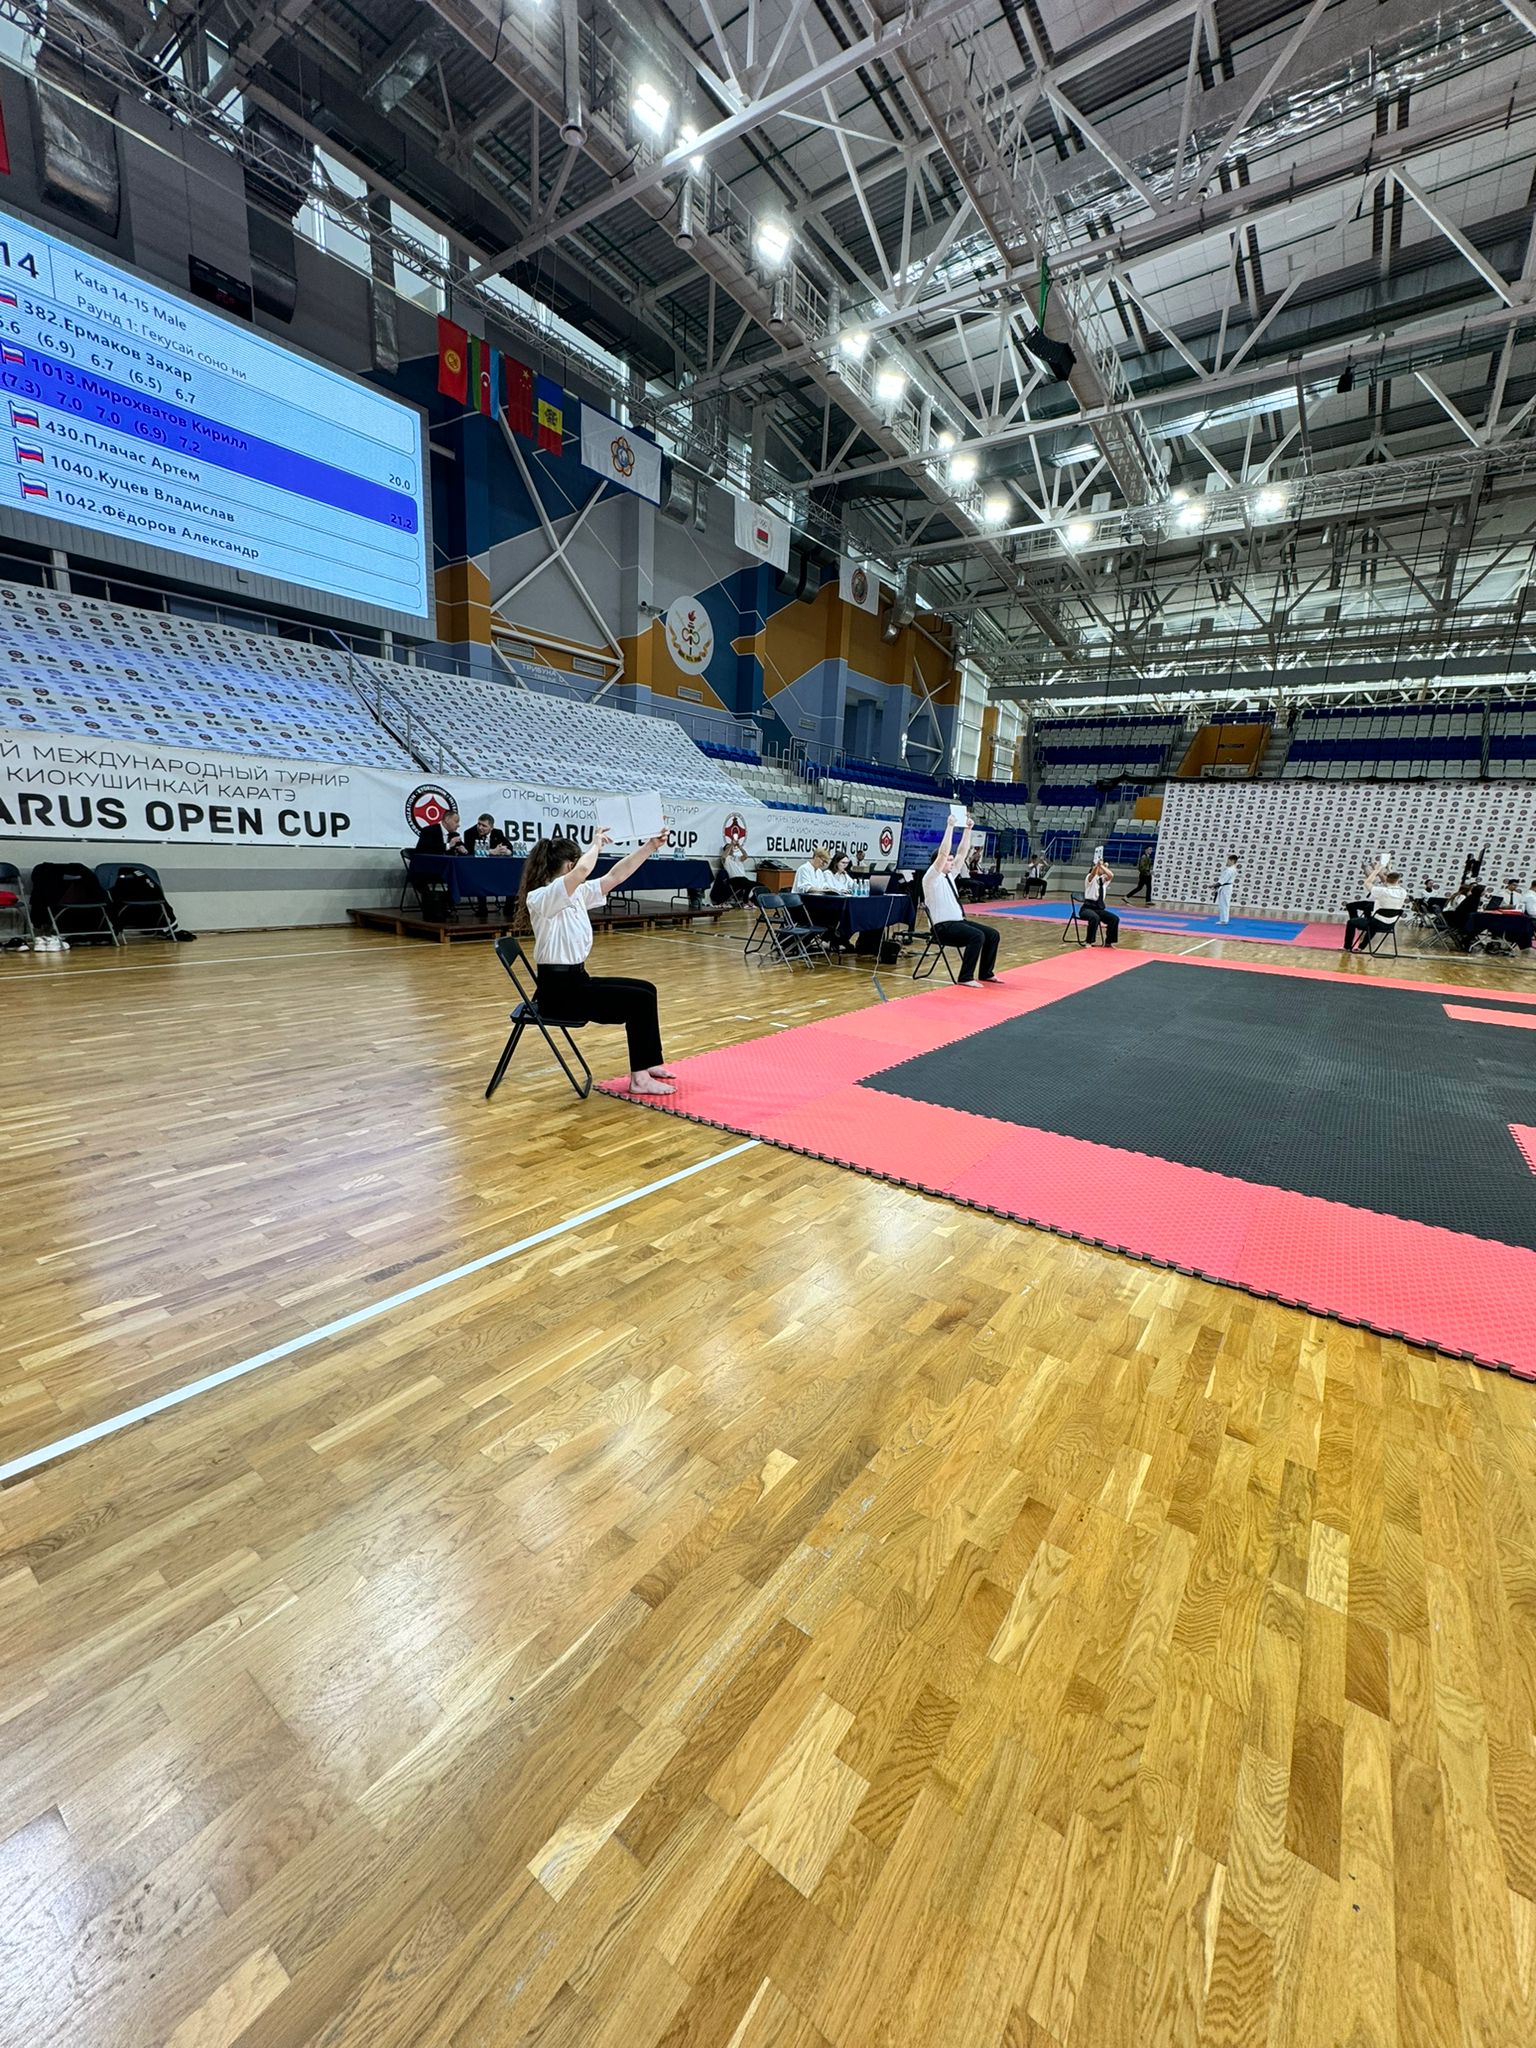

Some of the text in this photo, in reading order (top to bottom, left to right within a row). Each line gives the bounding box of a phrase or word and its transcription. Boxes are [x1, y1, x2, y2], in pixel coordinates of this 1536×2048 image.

[74, 269, 187, 331] Kata 14-15 Male
[23, 300, 192, 383] 382.Ермаков Захар
[77, 296, 247, 380] Раунд 1: Гекусай соно ни
[37, 332, 75, 358] (6.9)
[91, 354, 113, 371] 6.7
[129, 369, 162, 393] (6.5)
[175, 388, 196, 404] 6.7
[1, 372, 201, 454] (7.3) 7.0 7.0 (6.9) 7.2
[32, 358, 248, 451] 1013.Мирохватов Кирилл
[45, 421, 200, 482] 430.Плачас Артем
[51, 455, 235, 523] 1040.Куцев Владислав
[389, 473, 411, 490] 20.0
[56, 490, 259, 560] 1042.Фёдоров Александр
[390, 513, 412, 530] 21.2
[7, 766, 296, 801] КИОКУШИНКАЙ КАРАТЭ
[33, 745, 268, 782] МЕЖДУНАРОДНЫЙ
[275, 769, 350, 787] ТУРНИР
[502, 788, 570, 804] ОТКРЫТЫЙ
[542, 806, 560, 817] ПО
[667, 804, 700, 815] ТУРНИР
[145, 801, 263, 836] OPEN
[278, 809, 350, 838] CUP
[504, 820, 594, 845] BELARU
[666, 830, 698, 848] CUP
[766, 836, 819, 853] BELARUS
[821, 840, 848, 854] OPEN
[850, 841, 869, 855] CUP
